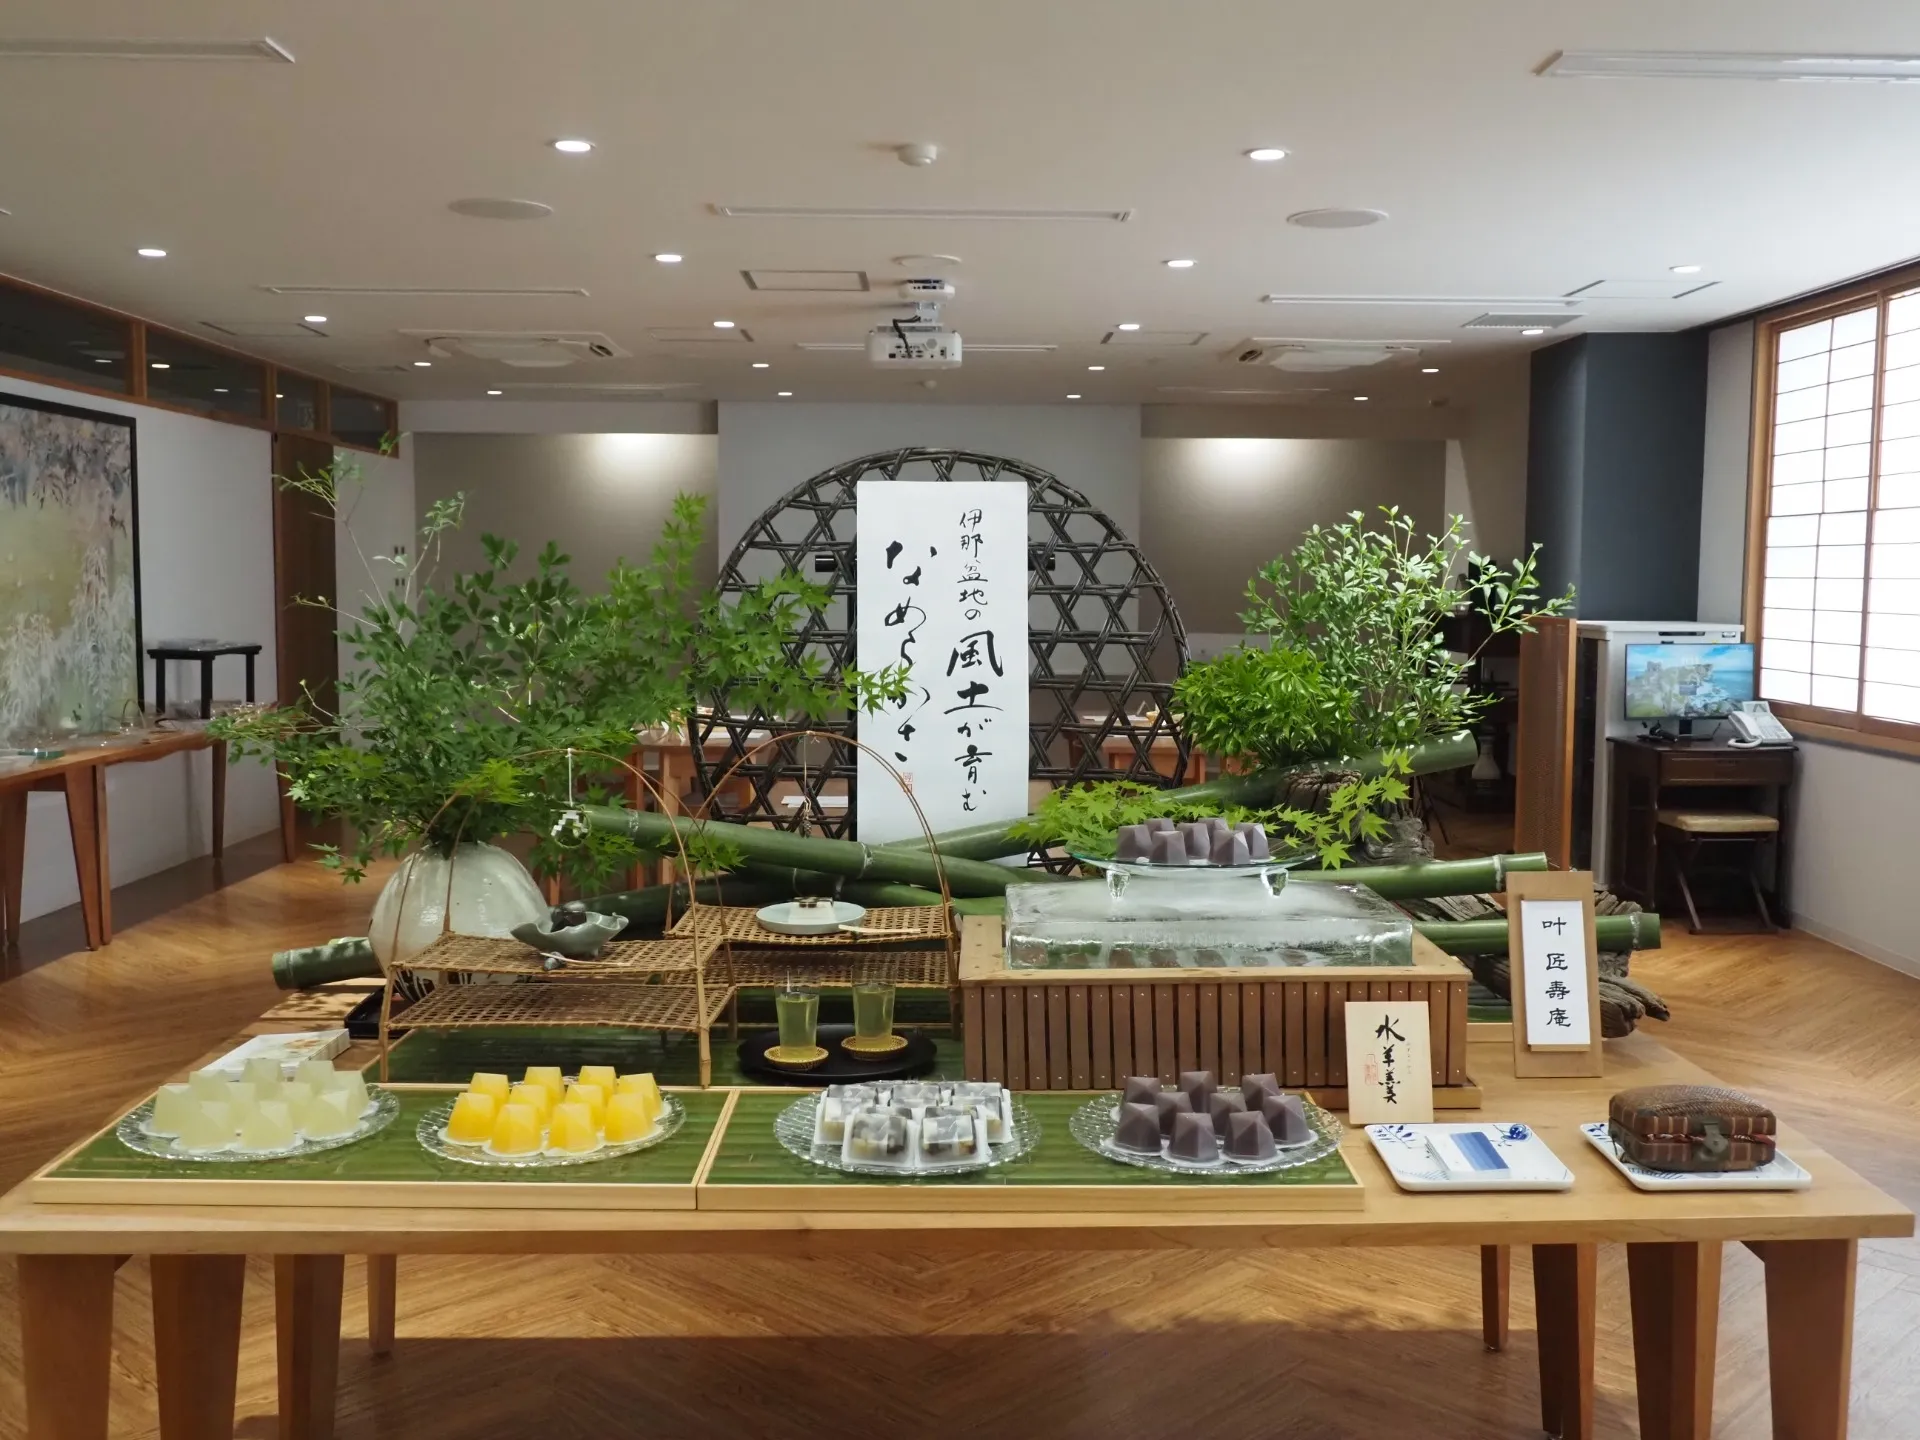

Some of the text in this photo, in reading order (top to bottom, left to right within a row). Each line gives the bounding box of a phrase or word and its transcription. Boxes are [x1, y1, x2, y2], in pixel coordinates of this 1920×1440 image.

[943, 508, 1004, 812] 伊那盆地の風土が育む
